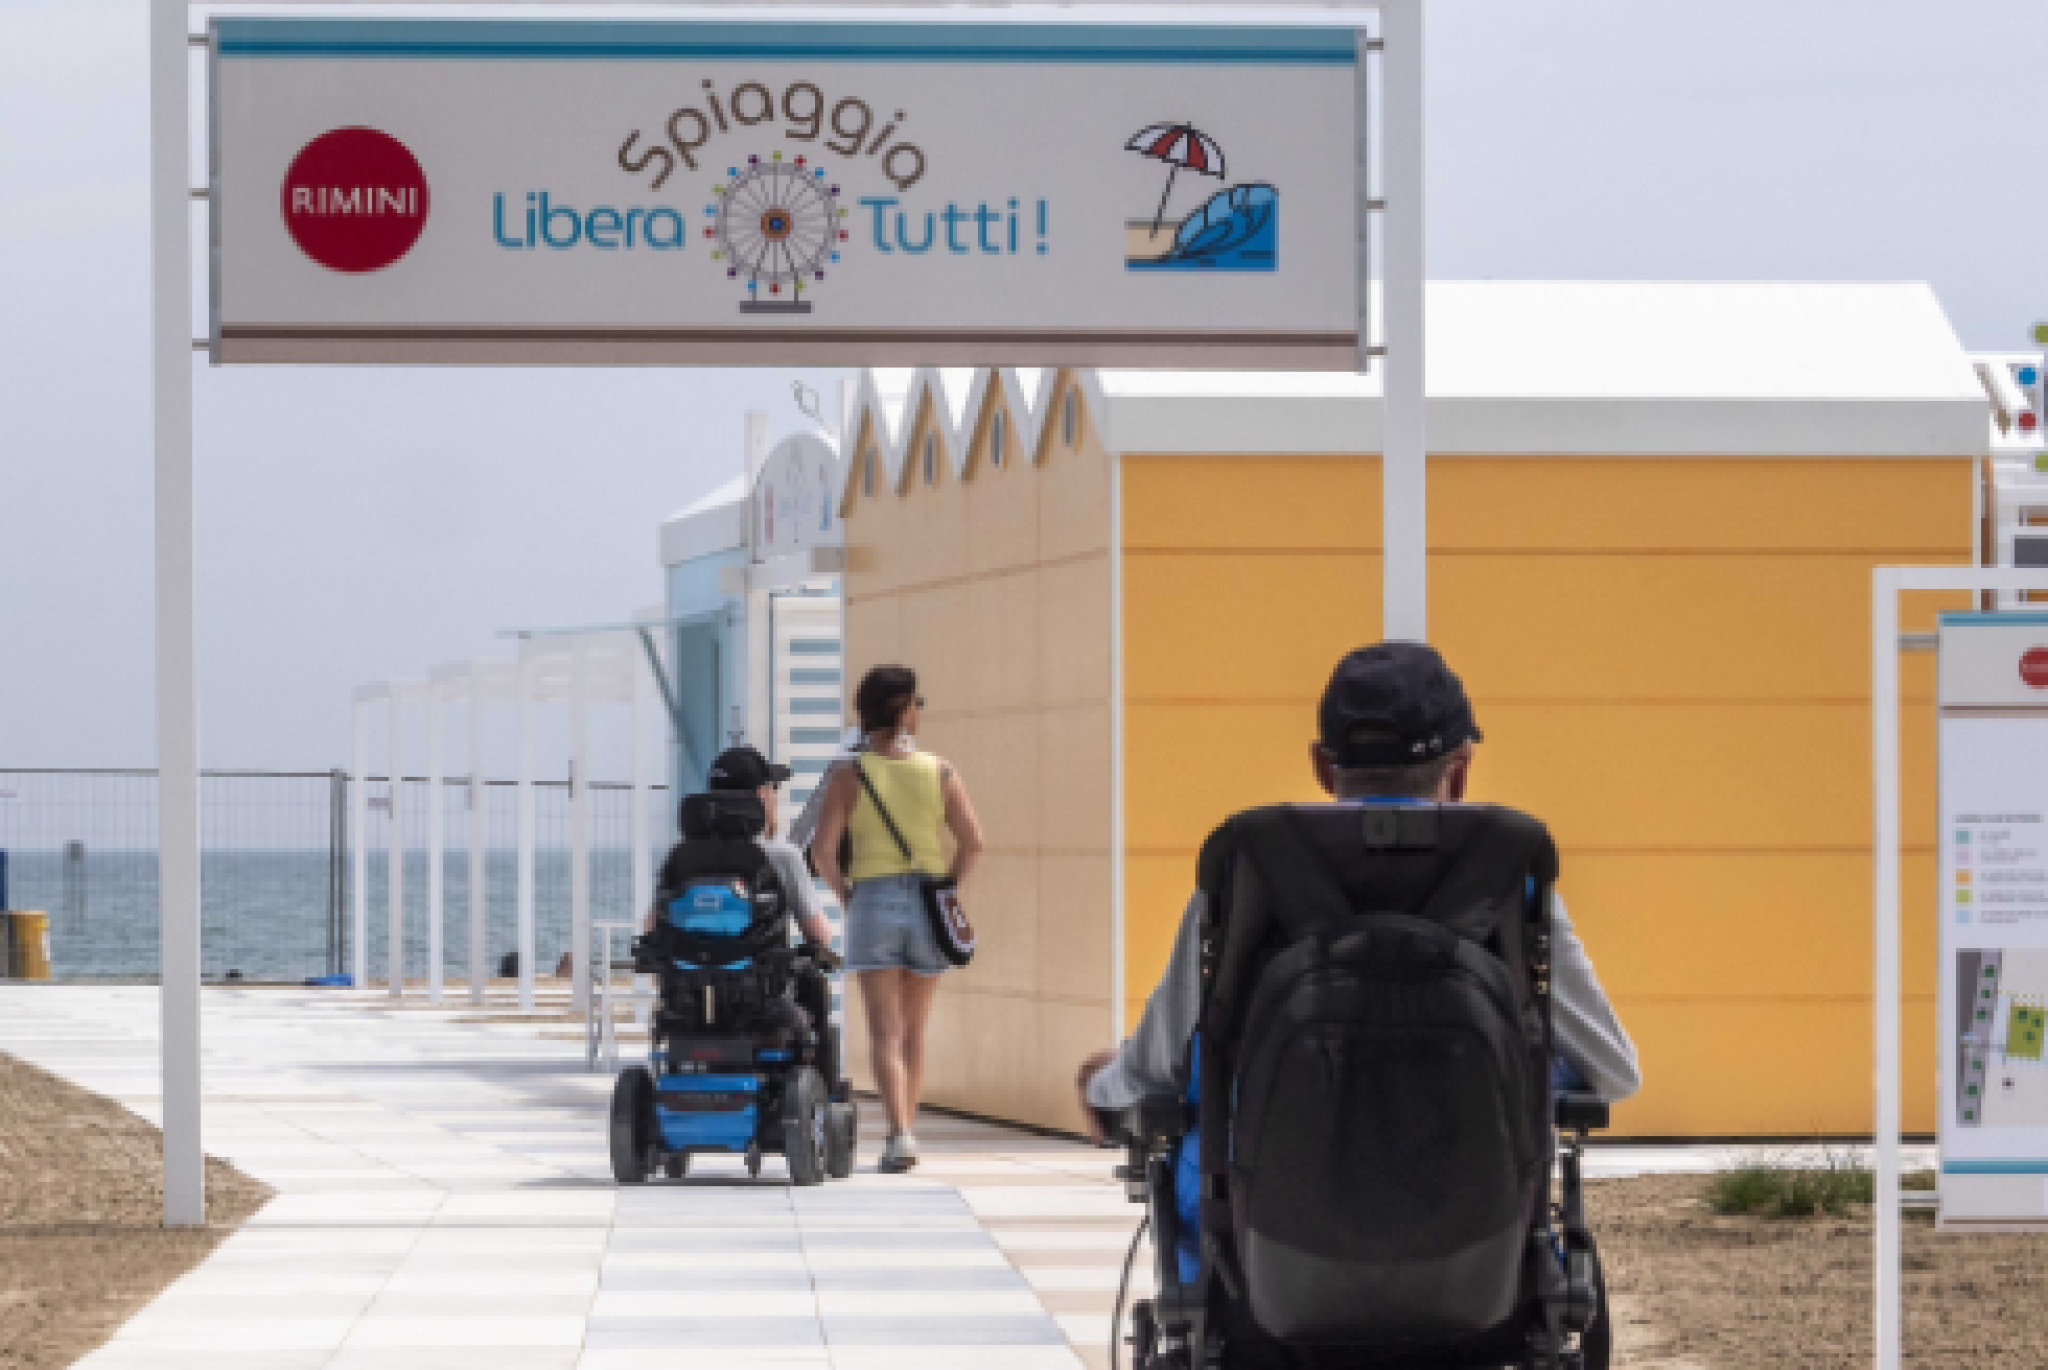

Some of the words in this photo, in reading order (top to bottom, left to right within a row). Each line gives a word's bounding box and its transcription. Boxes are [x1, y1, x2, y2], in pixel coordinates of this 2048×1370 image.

[617, 79, 926, 192] Spiaggia
[291, 186, 419, 215] RIMINI
[493, 189, 687, 250] Libera
